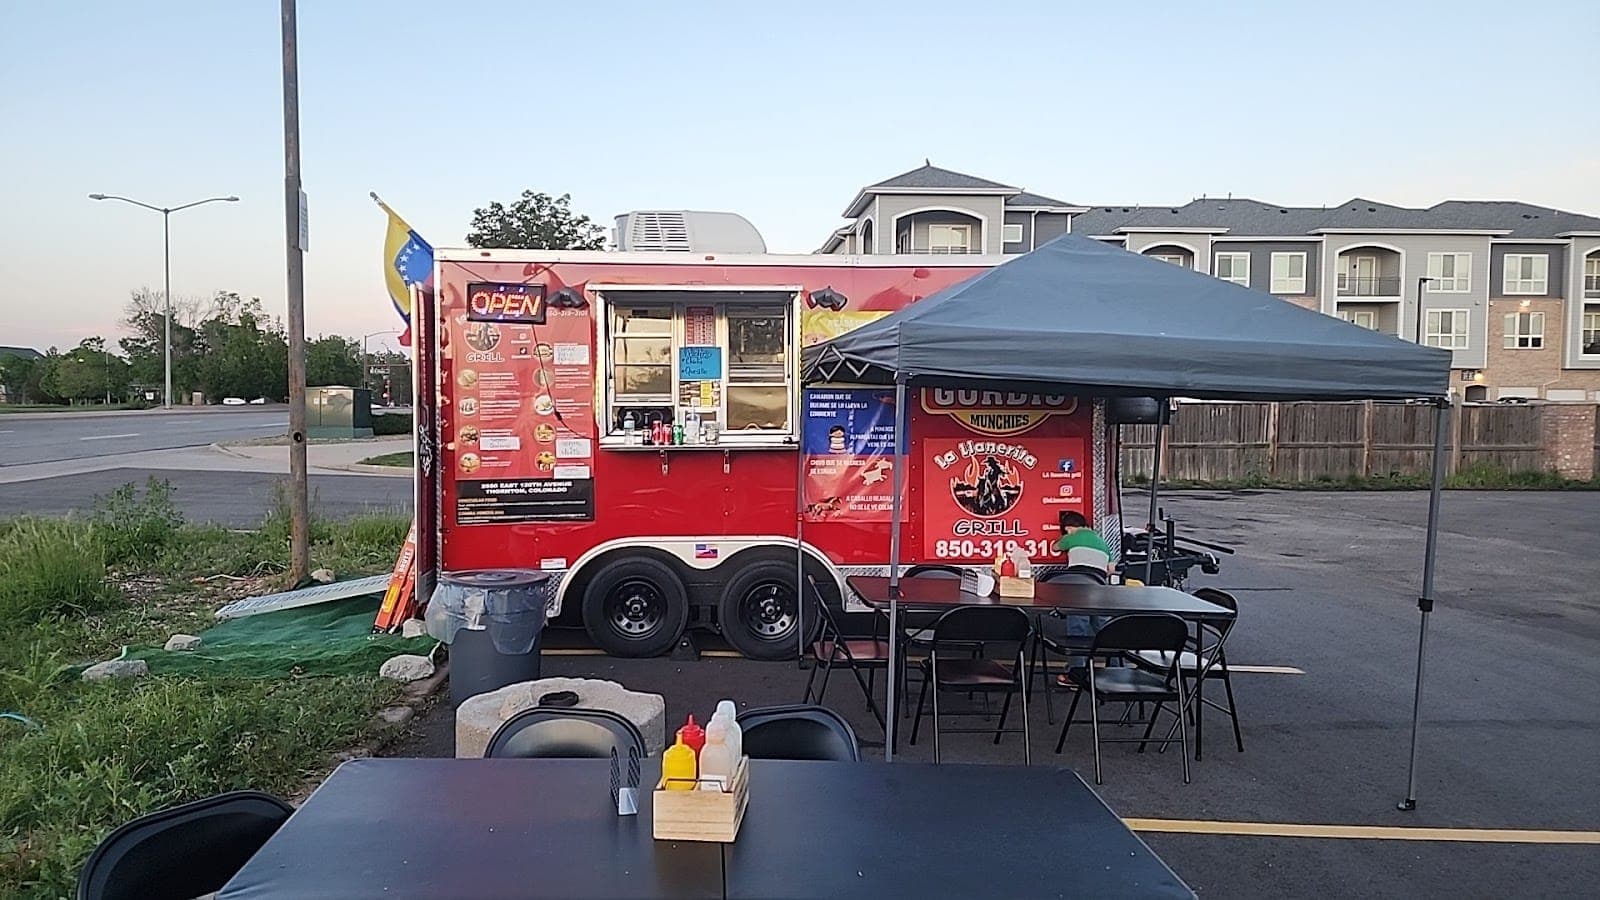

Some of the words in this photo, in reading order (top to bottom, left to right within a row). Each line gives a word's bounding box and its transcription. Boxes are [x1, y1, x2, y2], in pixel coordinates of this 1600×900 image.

[471, 291, 541, 316] OPEN
[466, 351, 505, 363] GRILL
[970, 414, 1030, 430] MUNCHIES
[934, 450, 959, 470] La
[953, 519, 1029, 537] GRILL
